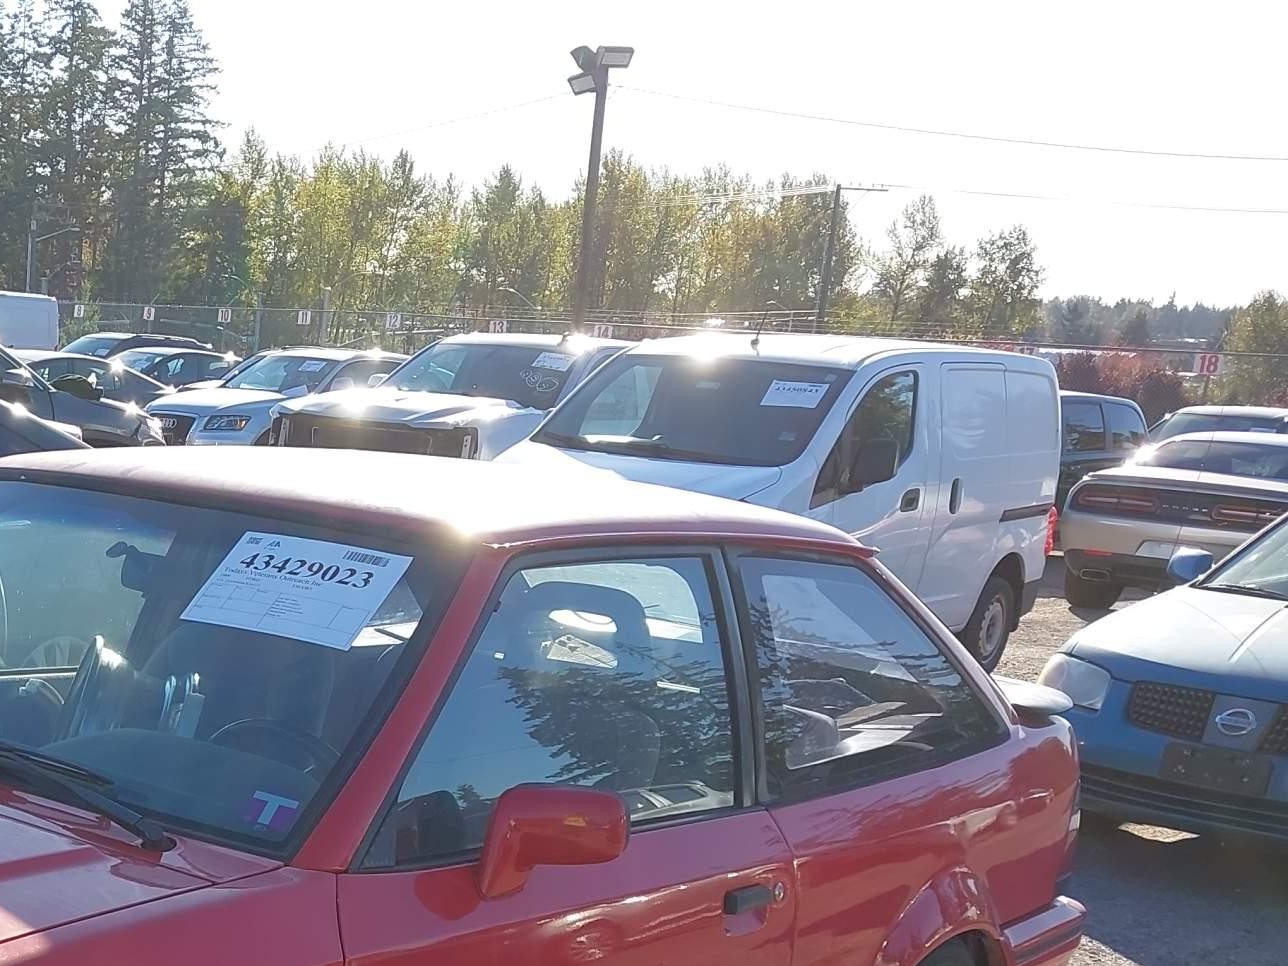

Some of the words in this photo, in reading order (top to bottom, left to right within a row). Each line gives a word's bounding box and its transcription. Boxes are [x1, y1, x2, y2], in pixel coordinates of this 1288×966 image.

[220, 309, 230, 322] 10
[389, 314, 399, 328] 12
[492, 320, 505, 333] 13
[597, 325, 610, 338] 14
[1199, 354, 1219, 374] 18
[239, 551, 374, 589] 43429023
[253, 790, 300, 825] T
